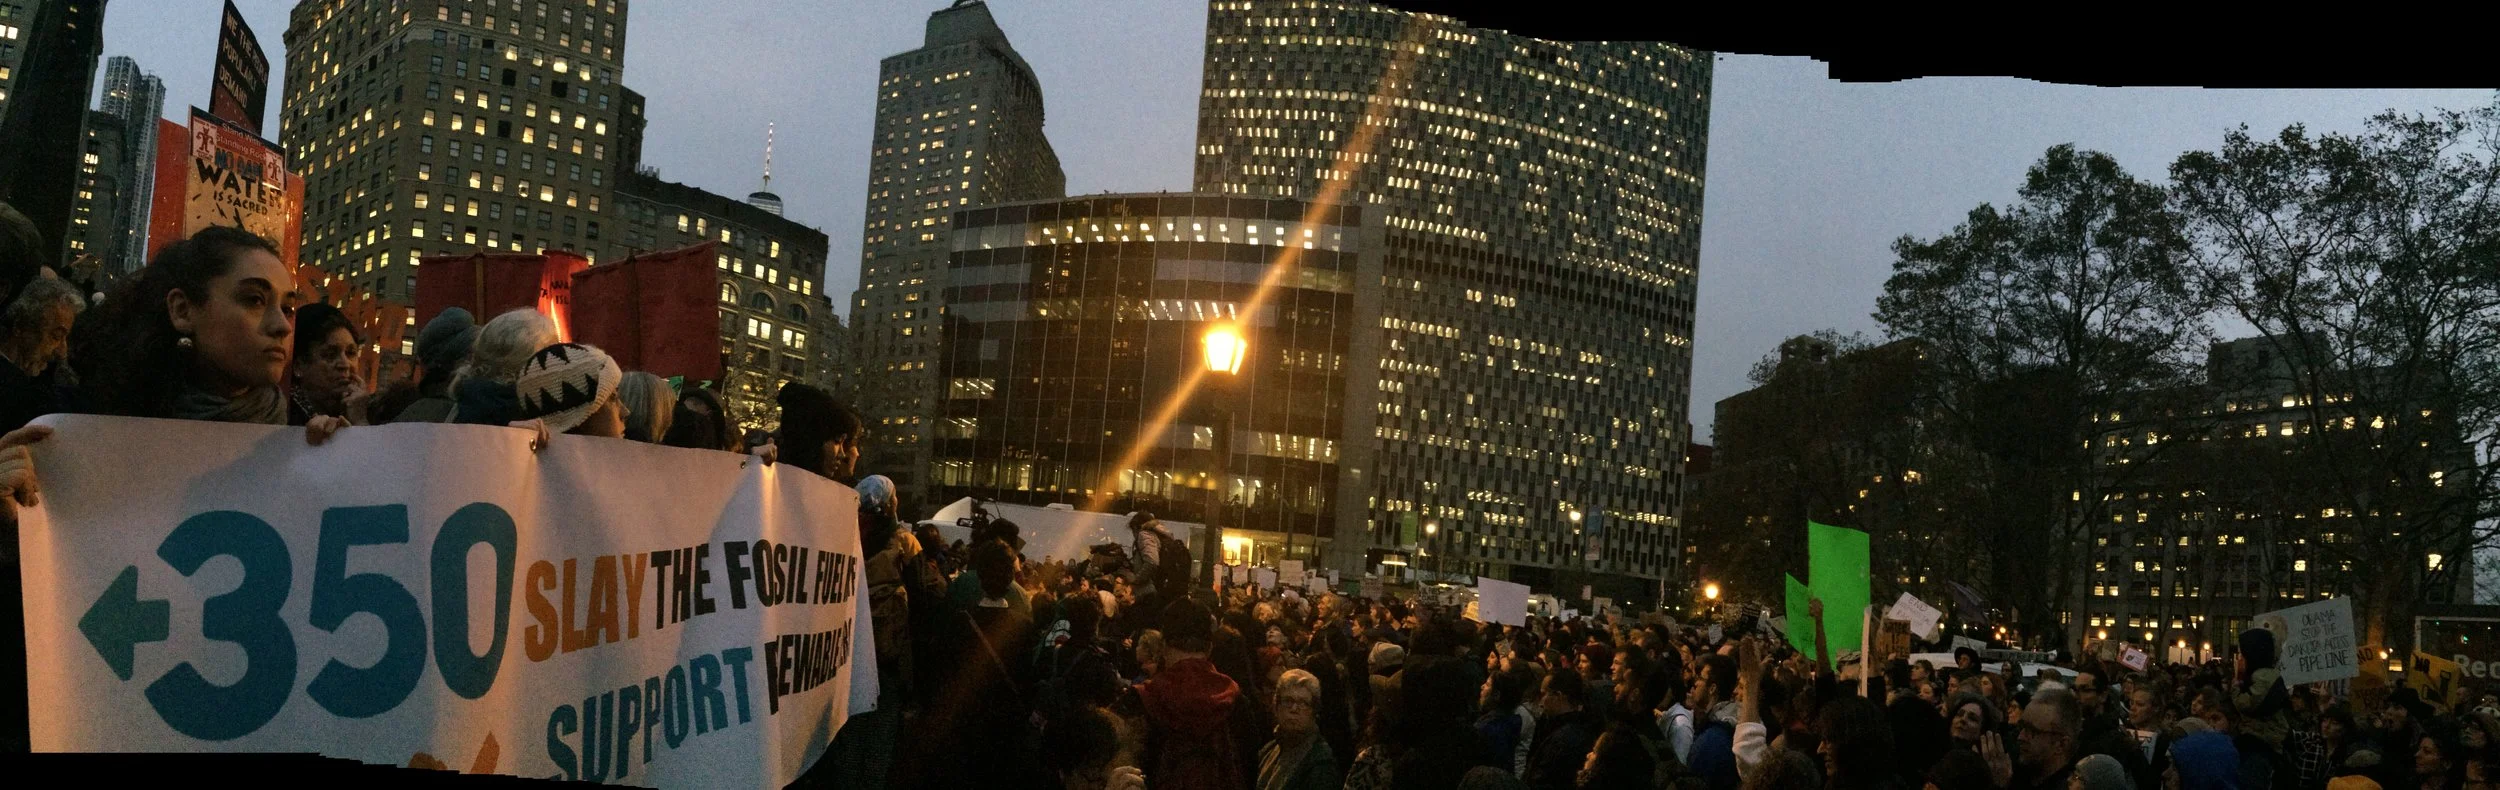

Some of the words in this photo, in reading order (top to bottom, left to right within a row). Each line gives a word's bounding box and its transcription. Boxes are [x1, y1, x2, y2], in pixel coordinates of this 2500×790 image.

[226, 10, 238, 36] WE
[239, 29, 253, 57] THE
[219, 64, 248, 109] DEMAND
[216, 133, 249, 155] Standing
[214, 191, 224, 202] IS
[227, 194, 268, 215] SACRED
[144, 501, 518, 741] 350
[524, 552, 648, 662] SLAY
[650, 543, 716, 630] THE
[723, 539, 808, 609] FOSIL
[2301, 609, 2336, 626] OBAMA
[547, 646, 753, 783] SUPPORT
